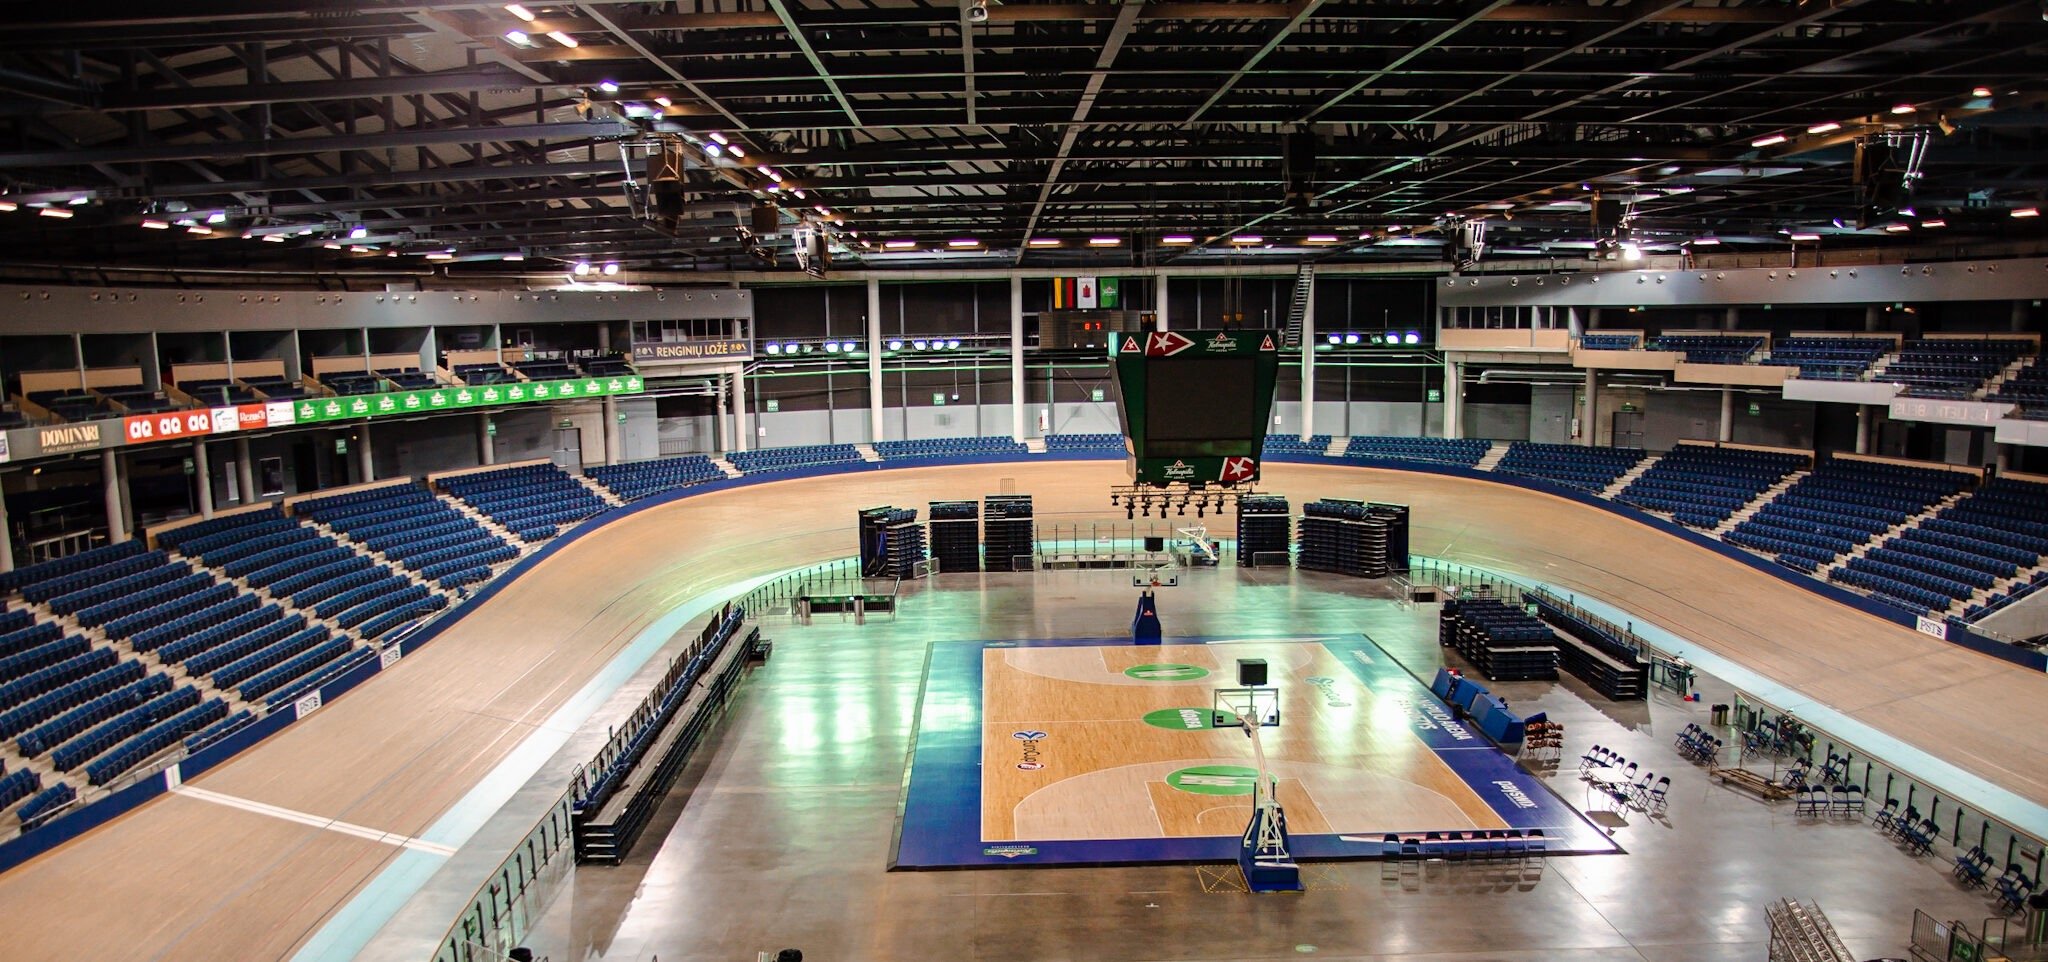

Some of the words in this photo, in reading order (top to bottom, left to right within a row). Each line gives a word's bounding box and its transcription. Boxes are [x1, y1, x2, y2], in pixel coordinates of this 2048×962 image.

[656, 345, 703, 357] RENGINIŲ
[704, 341, 729, 355] LOŽĖ
[41, 425, 99, 447] DOMINARI
[1920, 620, 1936, 633] PST
